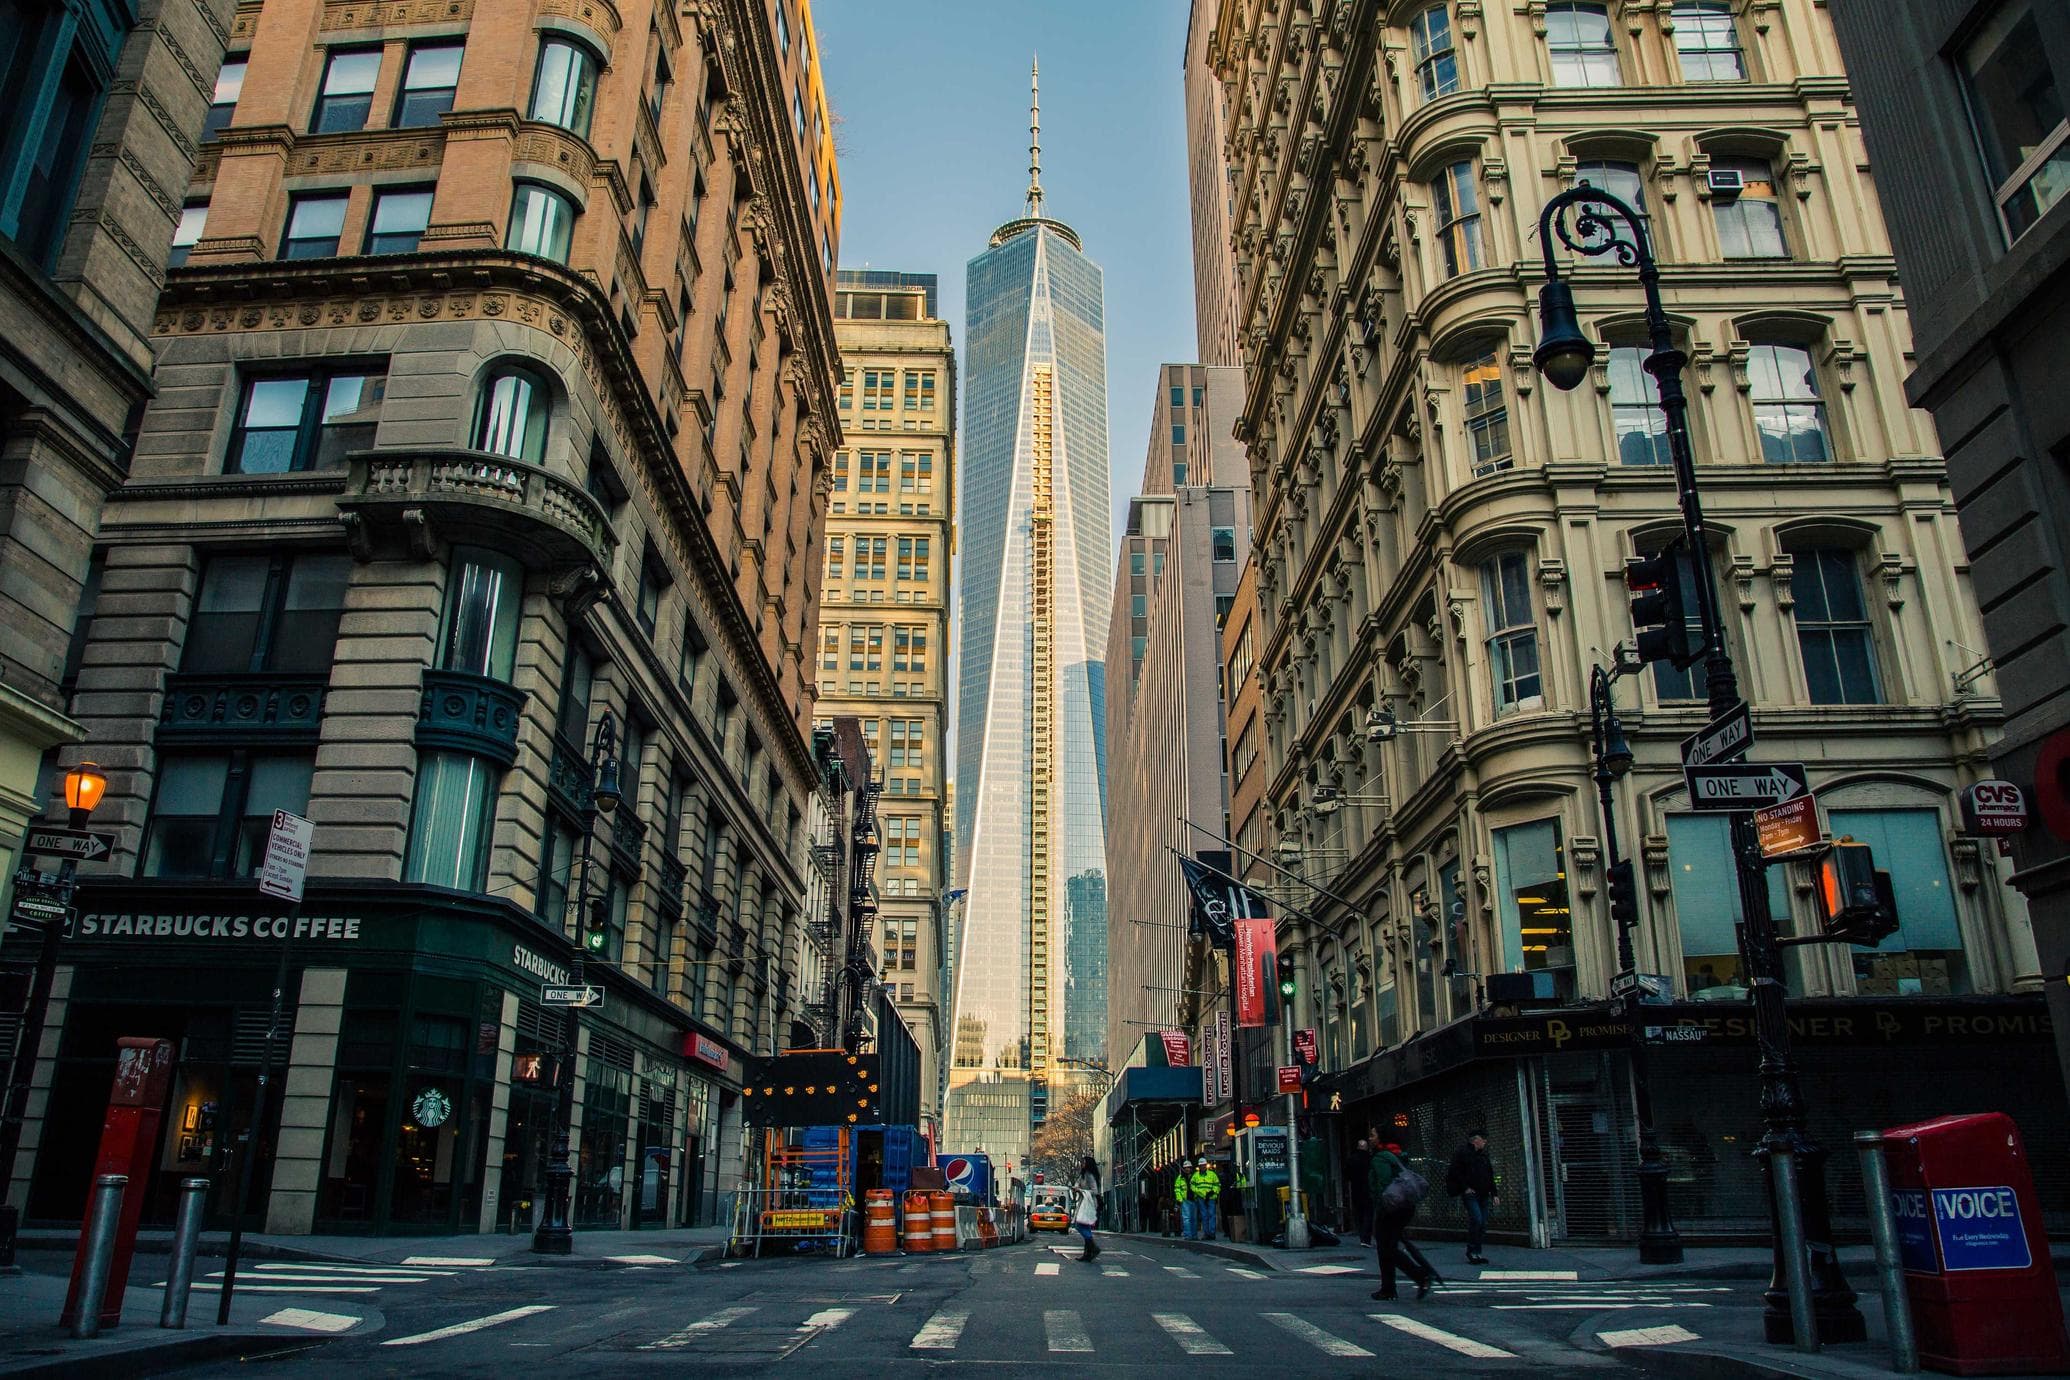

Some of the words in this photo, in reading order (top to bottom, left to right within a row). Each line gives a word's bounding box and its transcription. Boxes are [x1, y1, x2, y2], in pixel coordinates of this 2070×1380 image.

[1692, 742, 1713, 765] ONE
[1719, 721, 1742, 748] WAY
[1706, 779, 1741, 796] ONE
[1754, 778, 1790, 796] WAY
[1974, 785, 2020, 803] CVS
[1757, 812, 1769, 823] NO
[1769, 801, 1805, 820] STANDING
[1978, 803, 2021, 813] pharmacy
[275, 812, 284, 829] 3
[1759, 822, 1781, 833] Monday
[1785, 815, 1802, 825] Friday
[1980, 818, 1992, 827] 24
[1993, 818, 2023, 828] HOURS
[37, 836, 63, 848] ONE
[72, 839, 100, 853] WAY
[272, 832, 303, 850] COMMERCIAL
[271, 842, 293, 856] VEHICLES
[294, 848, 306, 859] ONLY
[82, 914, 249, 937] STARBUCKS
[253, 917, 362, 939] COFFEE
[513, 944, 565, 985] STARBUCKS
[550, 991, 568, 999] ONE
[1219, 1012, 1228, 1058] Roberts
[1483, 1030, 1542, 1044] DESIGNER
[1579, 1025, 1630, 1038] PROMISE
[1665, 1030, 1702, 1041] NASSAU
[1204, 1026, 1213, 1069] Roberts
[1205, 1070, 1213, 1105] Lucille
[1892, 1193, 1927, 1218] OICE
[1941, 1191, 2015, 1219] VOICE
